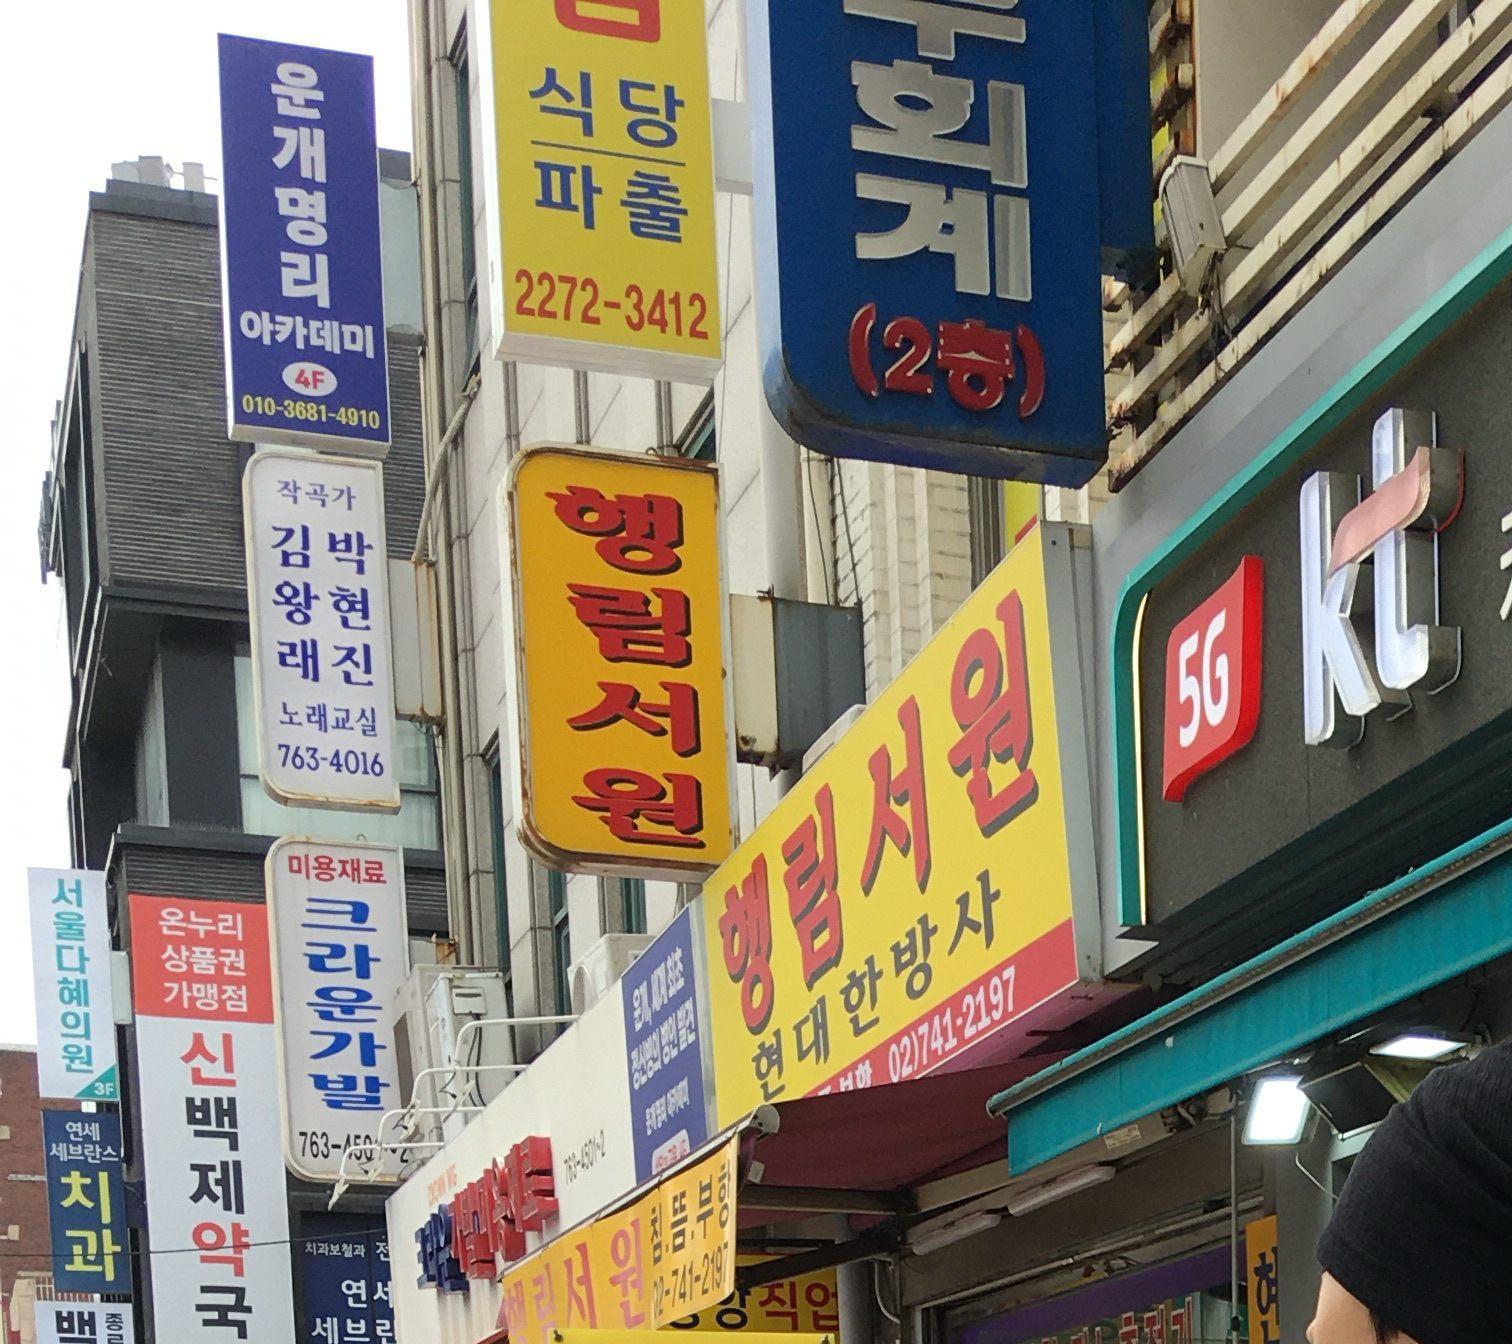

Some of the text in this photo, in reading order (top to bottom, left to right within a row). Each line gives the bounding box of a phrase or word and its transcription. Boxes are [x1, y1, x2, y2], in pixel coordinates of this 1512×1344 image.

[529, 67, 684, 150] 식당
[271, 62, 330, 309] 운개명리
[534, 159, 688, 243] 파출
[240, 310, 374, 359] 아카데미
[514, 269, 709, 341] 2272-3412
[295, 368, 324, 389] 4F
[849, 303, 1045, 416] (2층)
[242, 395, 380, 428] 010-3681-4910
[277, 479, 355, 510] 작곡가
[1300, 407, 1455, 749] kt
[545, 486, 705, 849] 행림서원
[1177, 609, 1230, 750] 5G
[280, 702, 377, 737] 노래교실
[278, 744, 384, 777] 763-4016
[720, 589, 1039, 1036] 행림서원
[288, 854, 387, 884] 미용재료
[158, 907, 243, 941] 온누리
[52, 878, 93, 1074] 서울다혜의원
[161, 945, 246, 976] 상품권
[164, 981, 247, 1012] 가맹점
[301, 897, 390, 1111] 크라운가발
[889, 968, 1017, 1083] 02)741-2197
[94, 1083, 113, 1096] 3F
[50, 1144, 120, 1163] 세브란스
[66, 1121, 100, 1142] 연세
[60, 1171, 121, 1281] 치과
[653, 1242, 728, 1318] 02-741-2197
